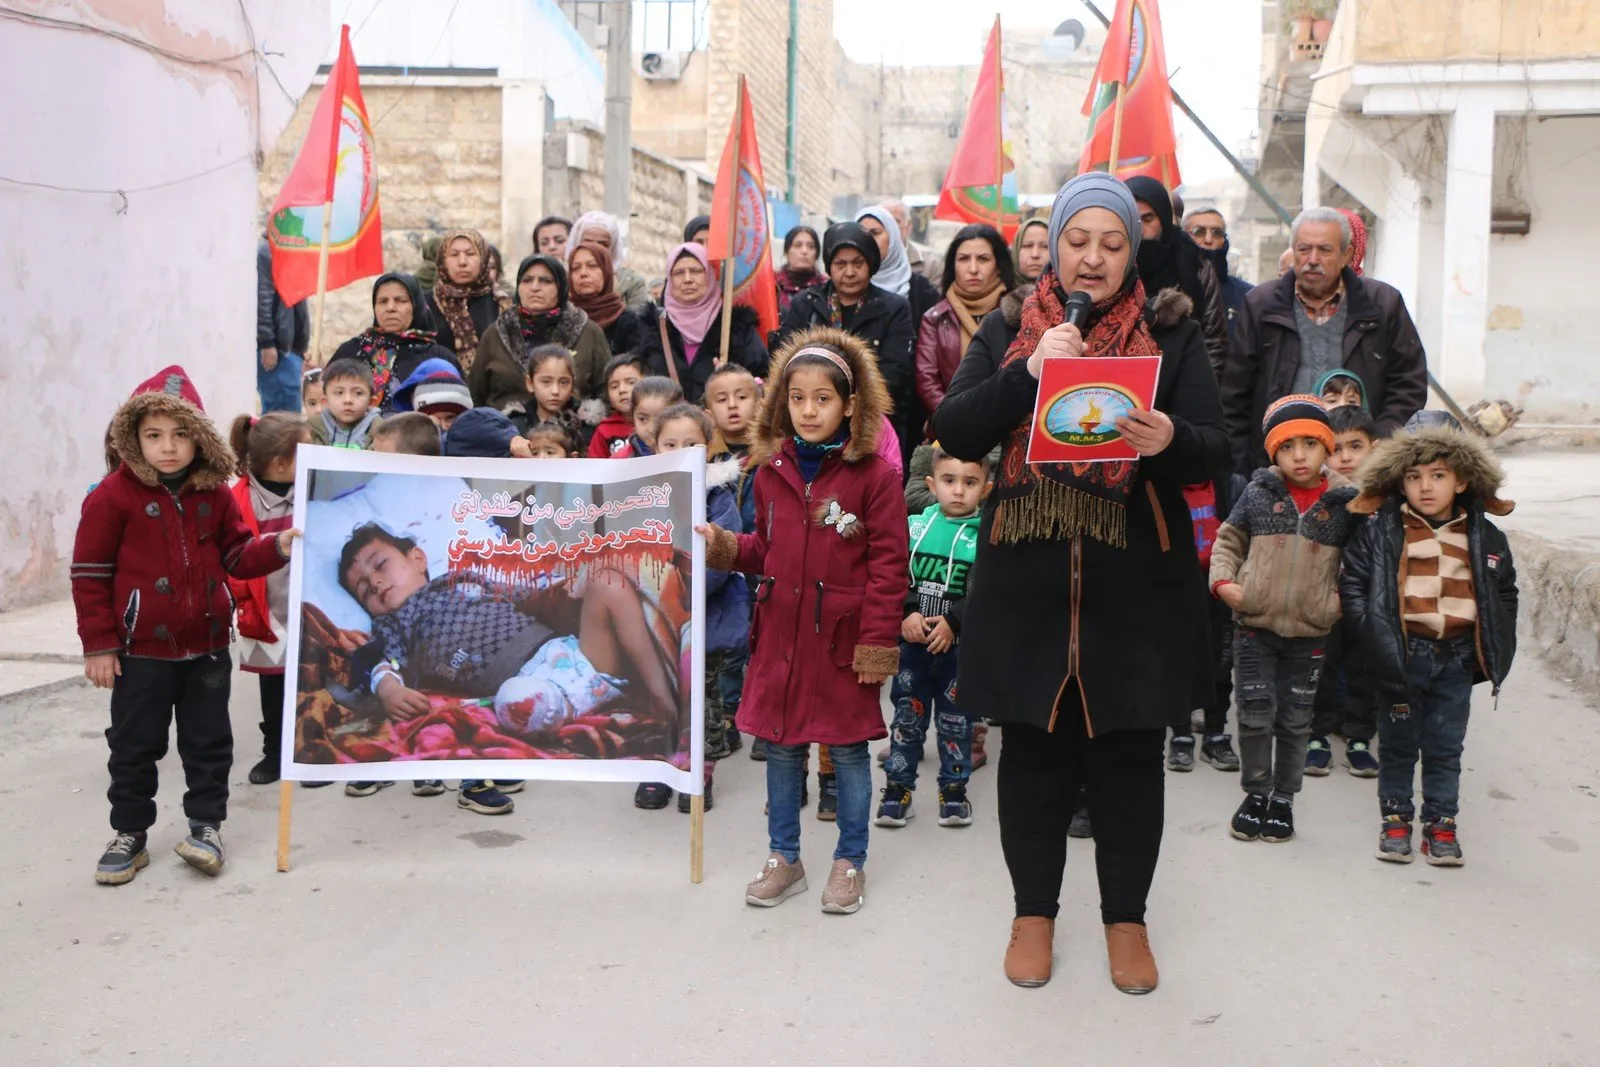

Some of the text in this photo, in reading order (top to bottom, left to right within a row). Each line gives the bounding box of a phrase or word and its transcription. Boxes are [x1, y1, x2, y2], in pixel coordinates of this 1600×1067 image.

[451, 489, 522, 524] طفولتي
[521, 494, 554, 525] من
[447, 528, 523, 562] مدرستي
[523, 531, 558, 562] من
